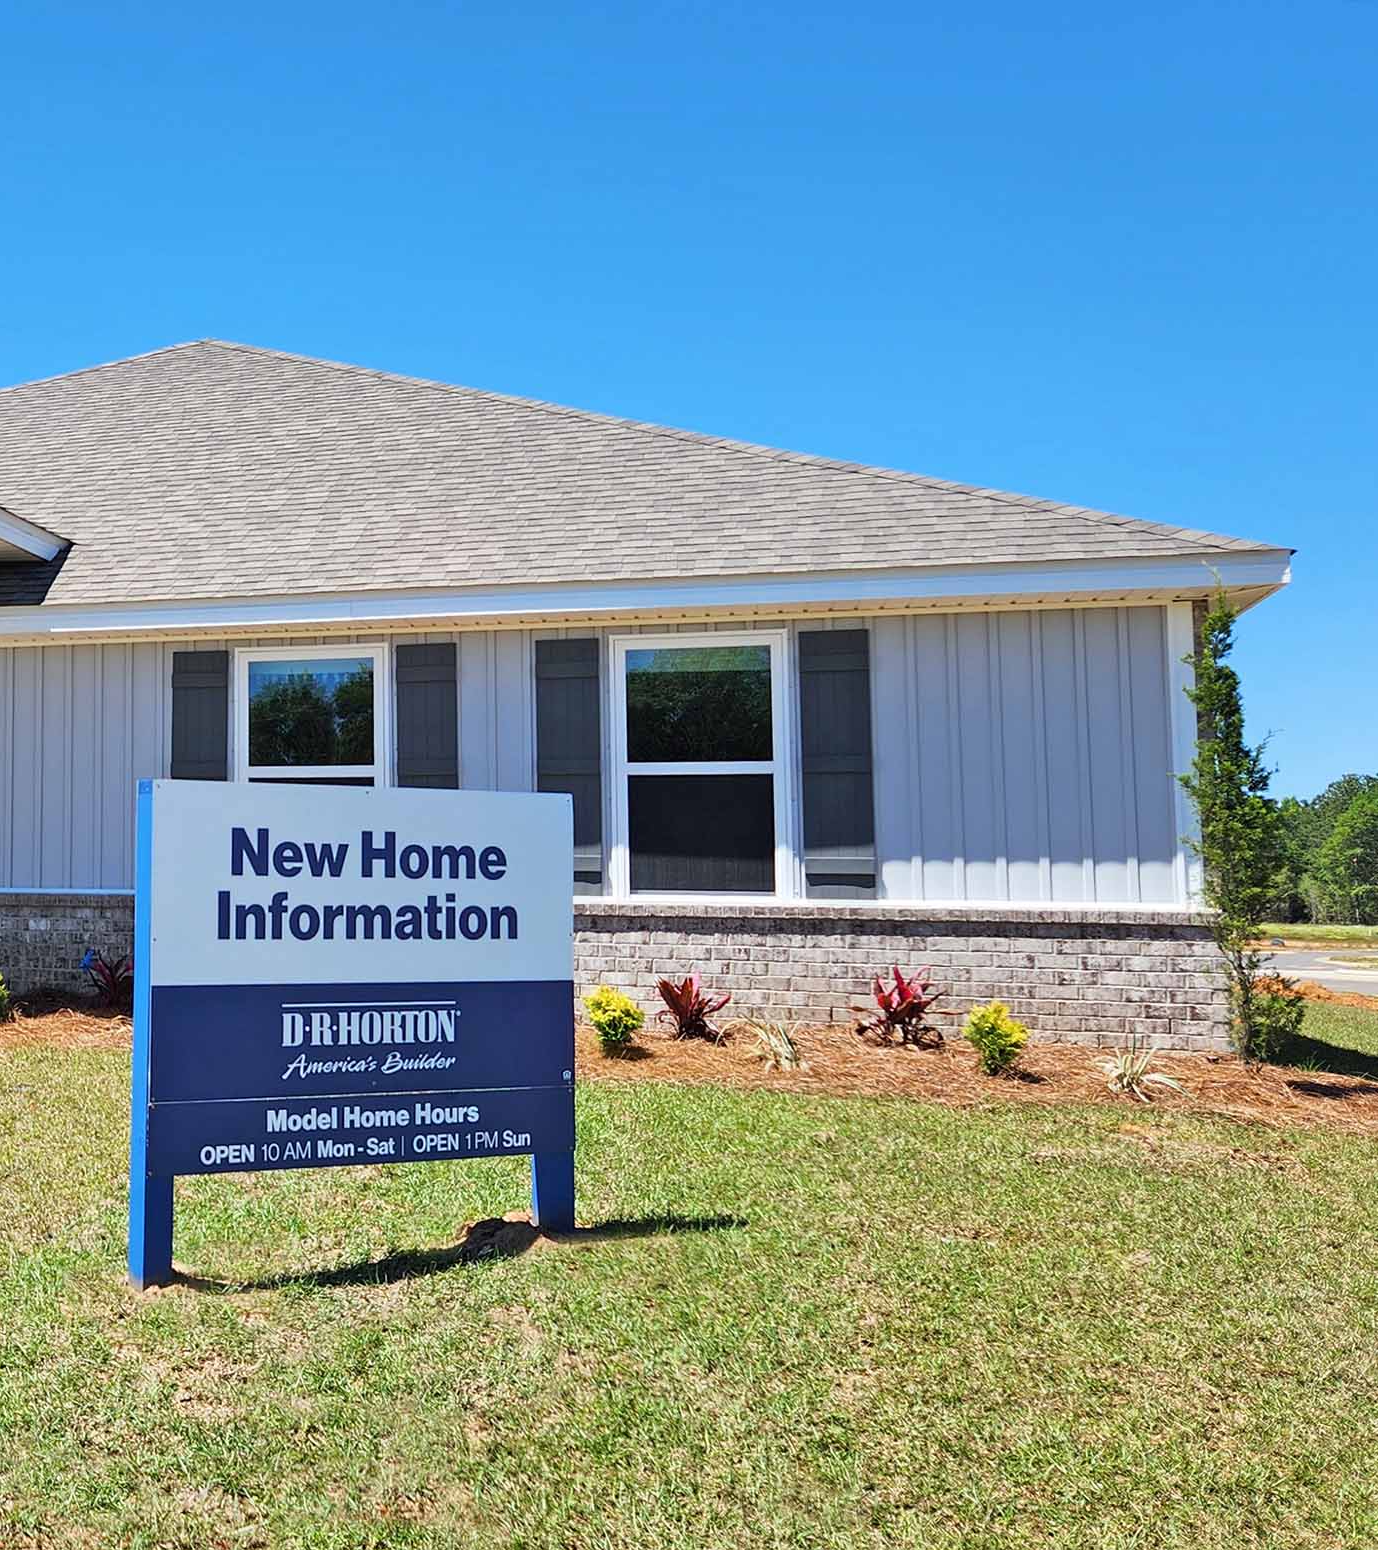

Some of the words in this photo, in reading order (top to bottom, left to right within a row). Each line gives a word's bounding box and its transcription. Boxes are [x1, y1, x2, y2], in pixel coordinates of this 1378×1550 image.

[230, 827, 350, 878] New
[360, 830, 508, 881] Home
[217, 890, 519, 941] Information
[281, 1053, 377, 1080] America's
[381, 1051, 456, 1075] Builder
[266, 1106, 338, 1133] Model
[343, 1104, 410, 1129] Home
[415, 1102, 480, 1126] Hours
[200, 1144, 255, 1165] OPEN
[261, 1143, 280, 1162] 10
[282, 1141, 312, 1161] AM
[413, 1133, 460, 1154] OPEN
[502, 1129, 531, 1148] Sun
